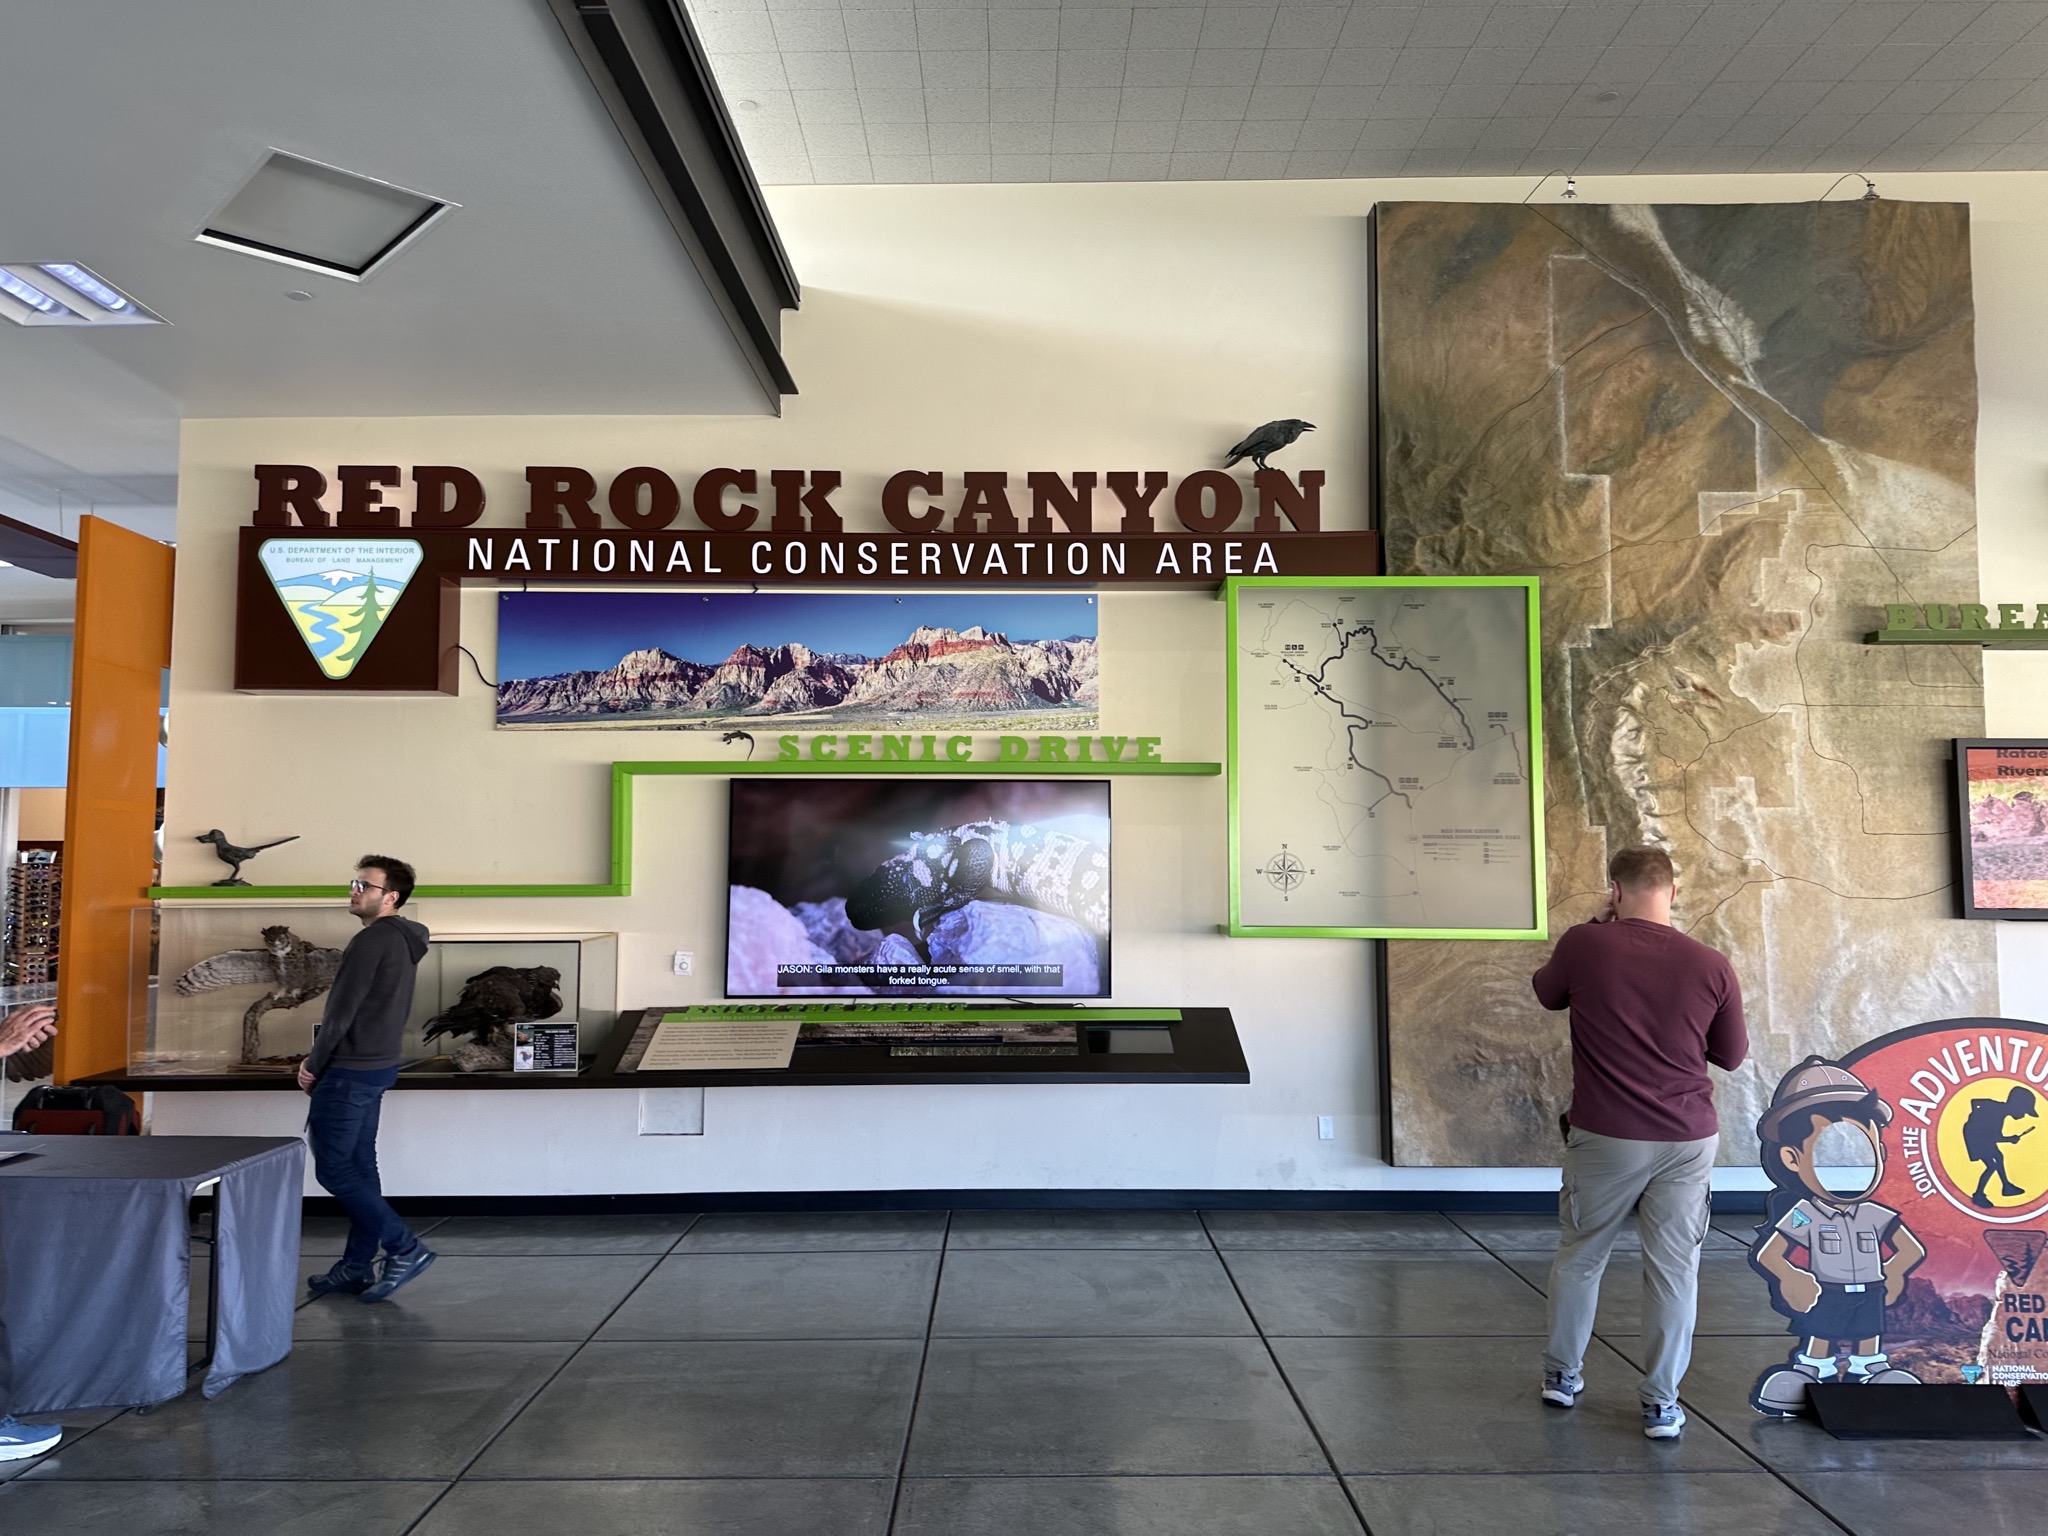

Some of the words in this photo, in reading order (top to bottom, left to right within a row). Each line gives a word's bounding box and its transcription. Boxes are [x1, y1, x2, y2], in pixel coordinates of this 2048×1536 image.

[253, 464, 486, 528] RED
[525, 466, 843, 532] ROCK
[882, 469, 1325, 533] CANYON
[376, 547, 415, 555] INTERIOR
[468, 537, 722, 573] NATIONAL
[751, 540, 1125, 575] CONSERVATION
[1156, 541, 1278, 575] AREA
[779, 734, 973, 762] SCENIC
[1000, 735, 1162, 763] DRIVE
[777, 965, 813, 974] JASON:
[815, 965, 833, 974] Gila
[835, 966, 875, 974] monsters
[877, 965, 898, 974] have
[908, 965, 932, 975] really
[933, 966, 956, 974] acute
[986, 965, 996, 974] of
[997, 965, 1022, 975] smell,
[1024, 965, 1042, 974] with
[1043, 965, 1060, 974] that
[889, 976, 916, 985] forked
[918, 977, 950, 986] tongue.
[687, 1004, 779, 1013] ENJOY
[783, 1003, 844, 1012] THE
[854, 1002, 968, 1012] DESERT
[1899, 1035, 2048, 1125] ADVENTU
[1903, 1126, 1920, 1159] THE
[1907, 1160, 1937, 1199] JOIN
[2004, 1293, 2046, 1313] RED
[1988, 1348, 2032, 1359] National
